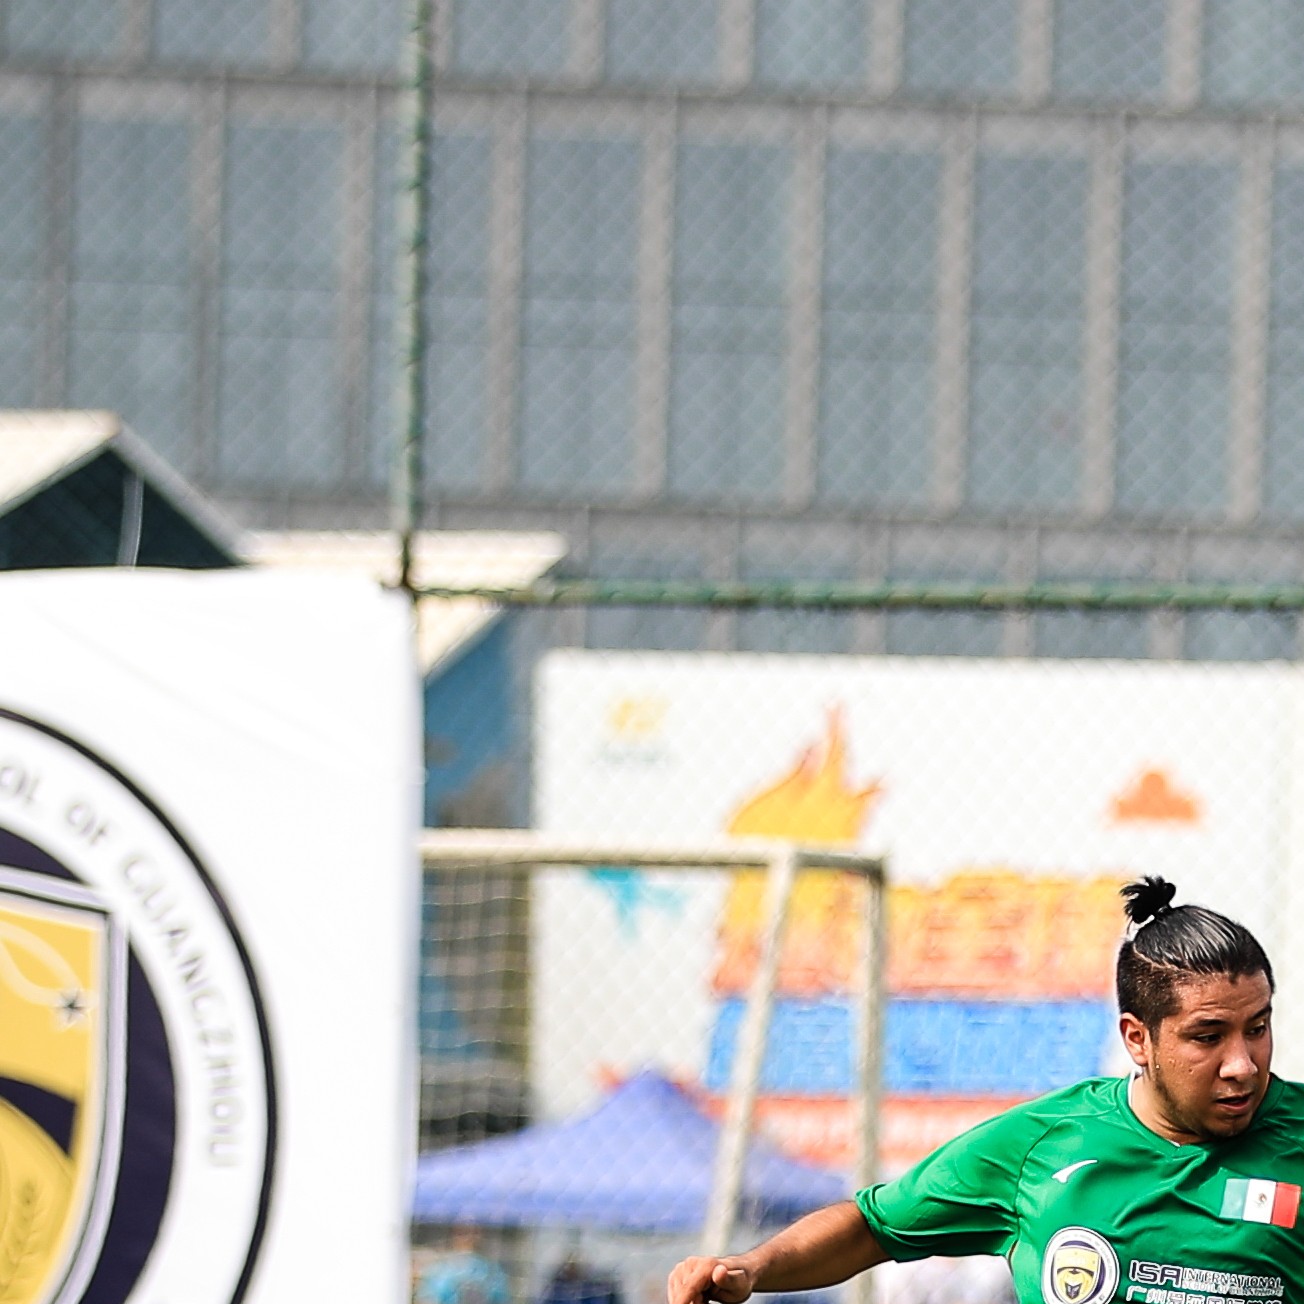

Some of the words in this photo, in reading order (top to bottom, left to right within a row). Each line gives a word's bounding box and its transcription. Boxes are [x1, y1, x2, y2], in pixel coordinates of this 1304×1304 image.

[64, 800, 110, 847] OF
[120, 852, 244, 1168] GUANGZHOU
[1129, 1259, 1184, 1288] ISA
[1183, 1267, 1283, 1288] INTERNATIONAL
